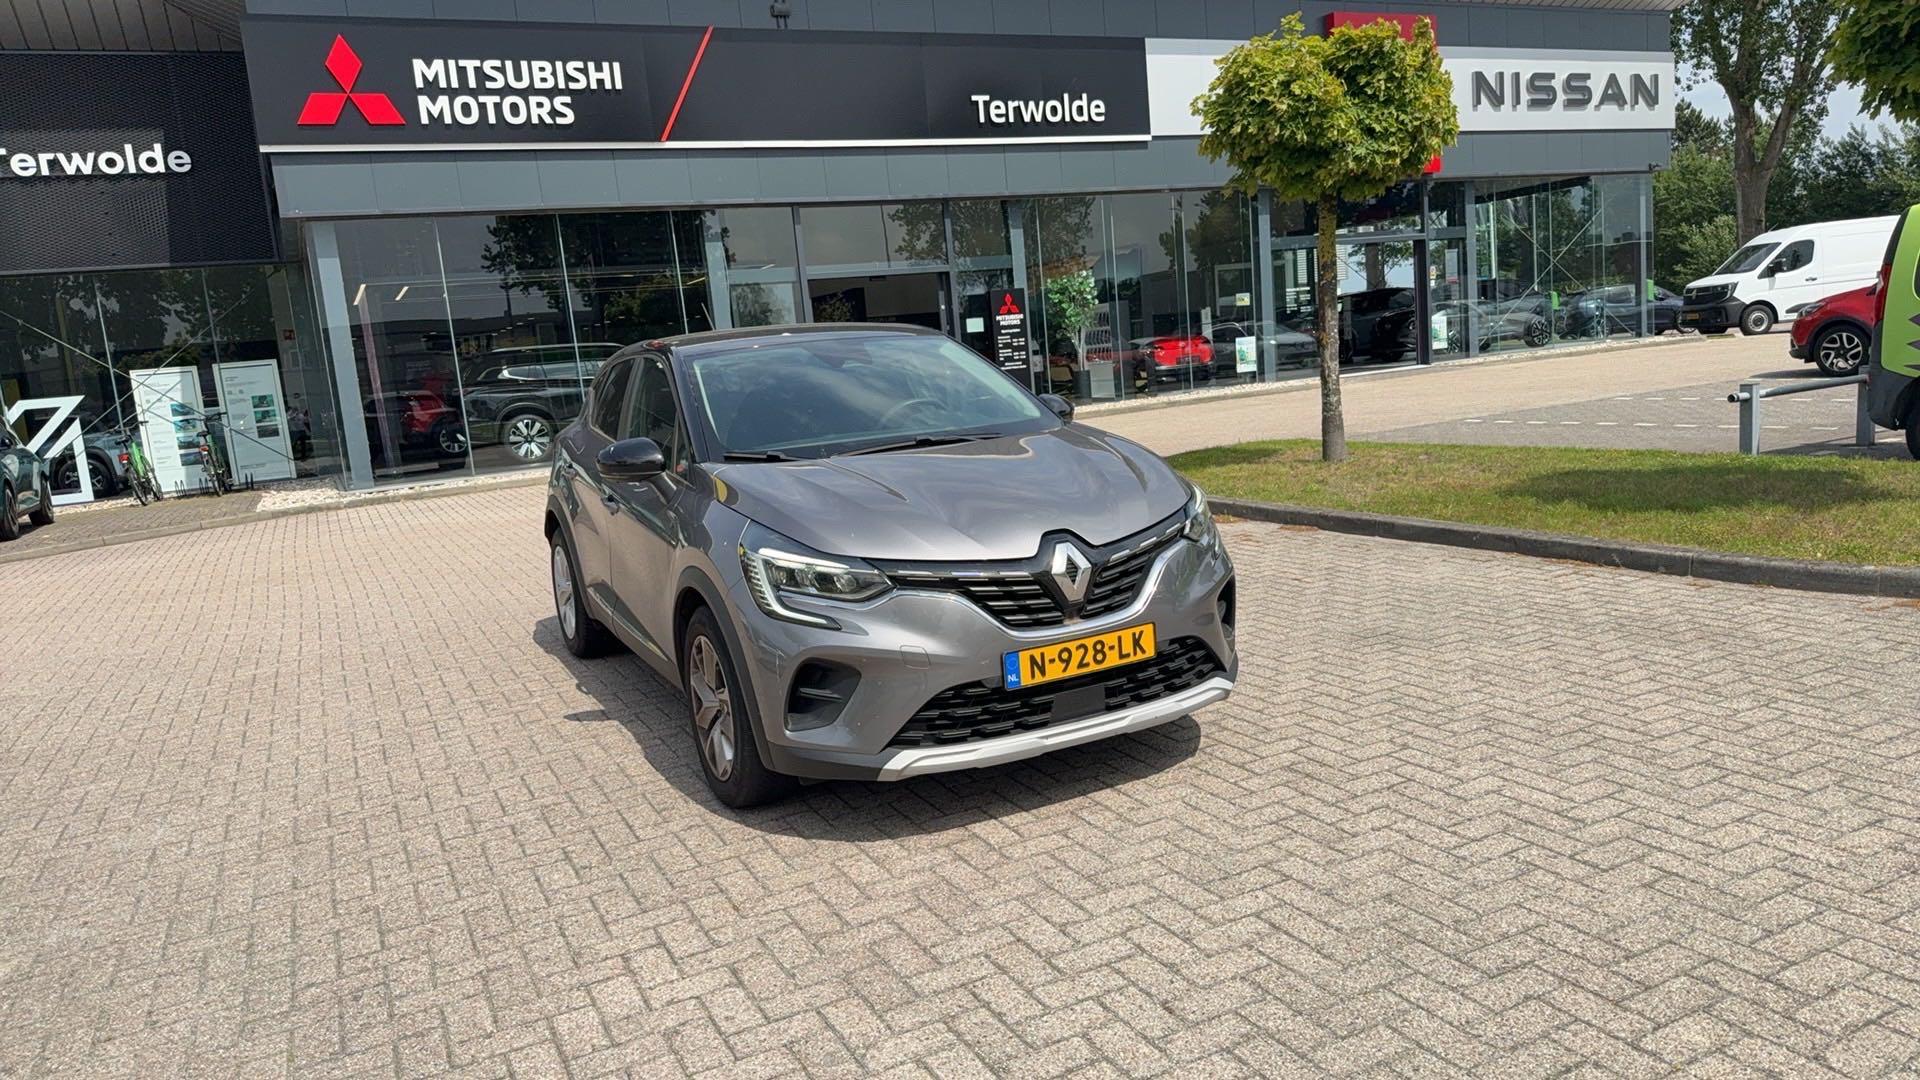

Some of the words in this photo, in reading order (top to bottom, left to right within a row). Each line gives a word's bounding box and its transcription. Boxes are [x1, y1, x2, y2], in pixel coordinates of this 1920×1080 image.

[412, 58, 623, 90] MITSUBISHI
[1471, 71, 1660, 111] NISSAN
[417, 95, 575, 125] MOTORS
[971, 93, 1106, 123] Terwolde
[1029, 630, 1146, 680] N-928-LK
[1007, 673, 1019, 682] NL
